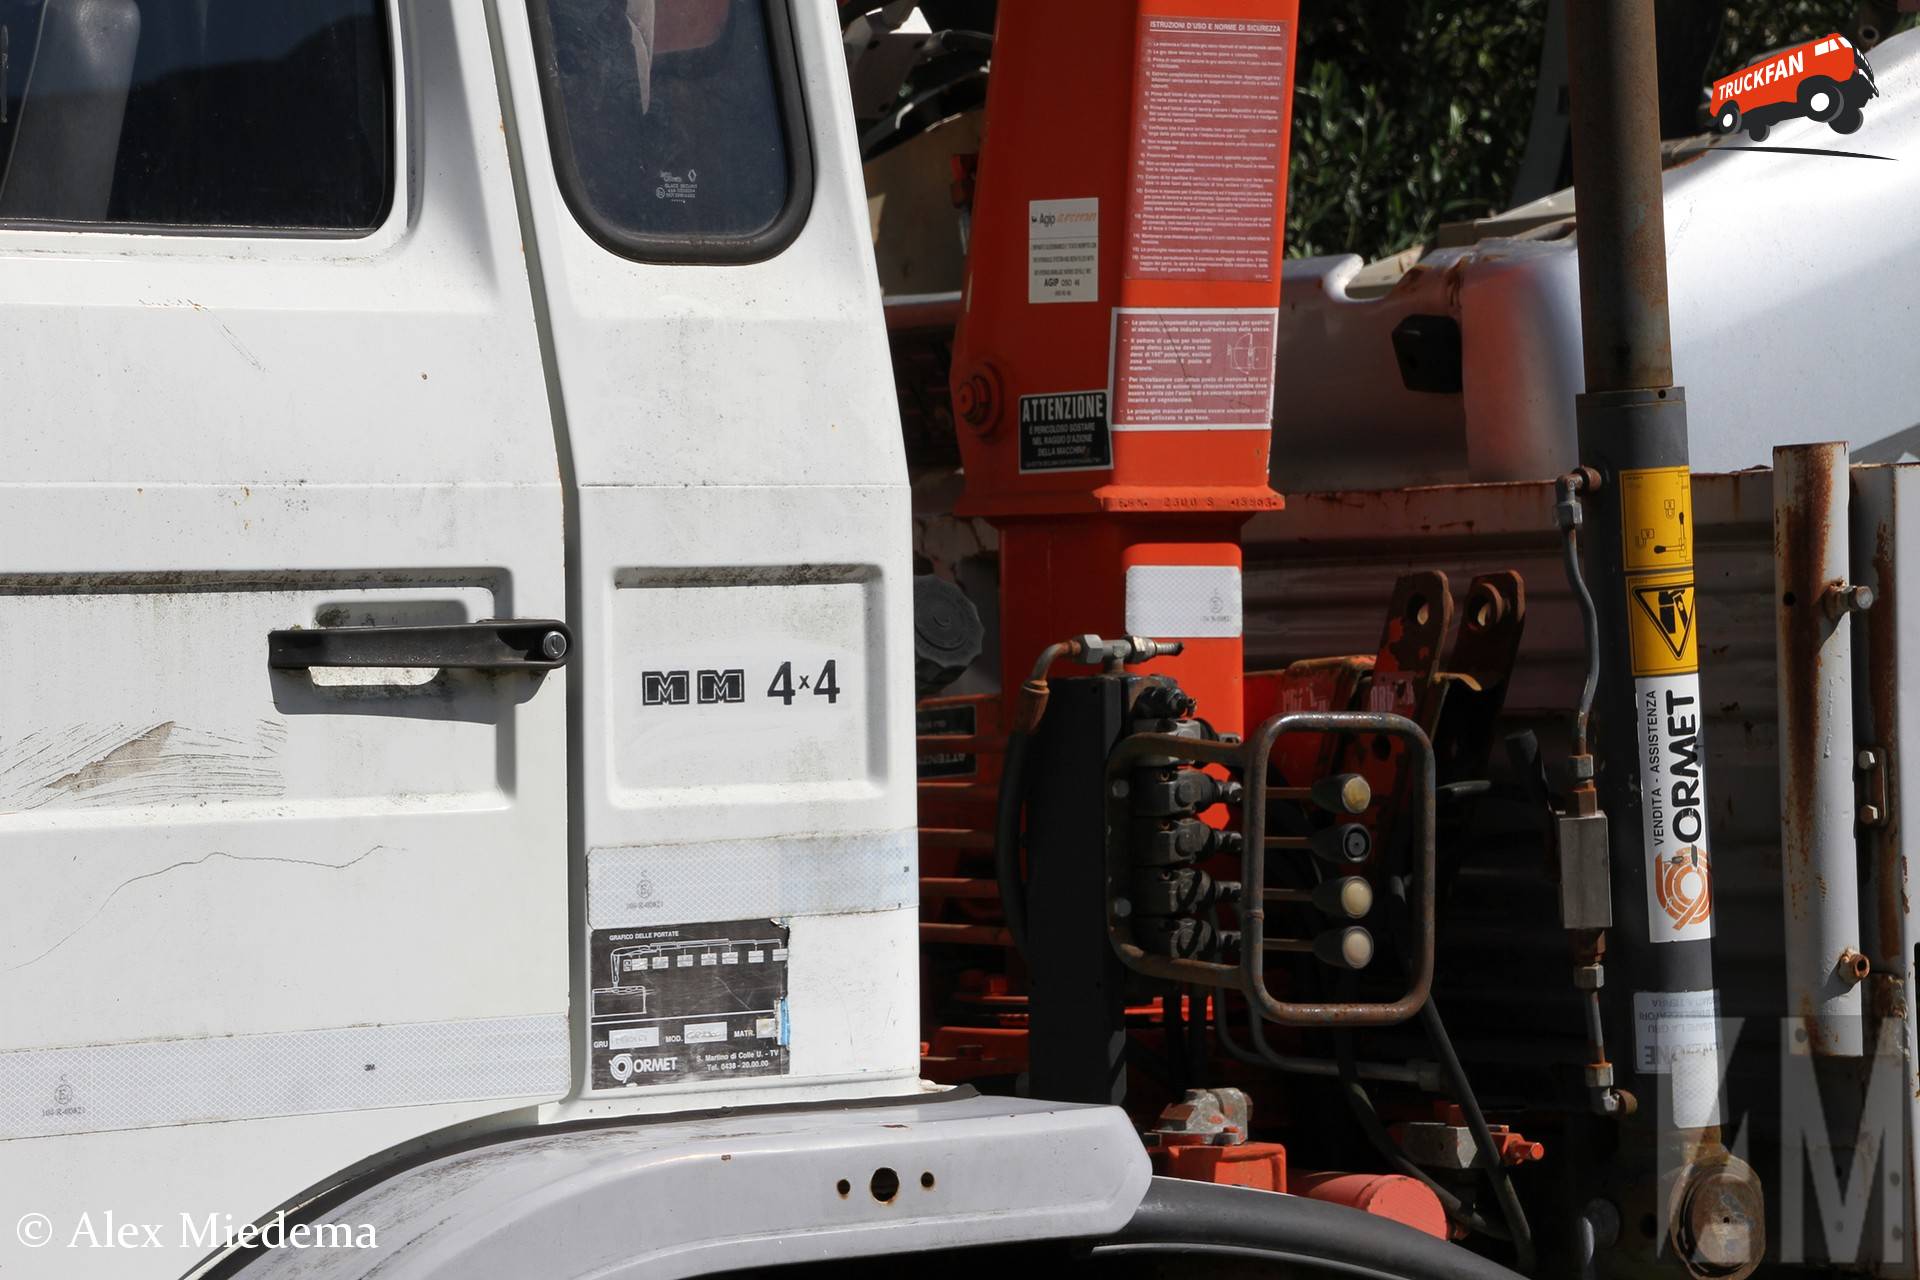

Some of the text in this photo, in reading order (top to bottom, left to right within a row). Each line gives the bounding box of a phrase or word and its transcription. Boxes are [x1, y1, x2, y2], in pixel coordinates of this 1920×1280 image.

[1150, 21, 1185, 30] ISTRUZIONI
[1214, 23, 1237, 31] NORME
[1247, 24, 1281, 33] SICUREZZA
[1022, 394, 1104, 423] ATTENZIONE
[1645, 690, 1660, 774] ASSISTENZA
[1665, 689, 1702, 843] ORMET
[1651, 787, 1664, 846] VENDITA
[609, 930, 679, 942] GRAFICO DELLE PORTATE
[593, 1041, 608, 1049] GRU
[665, 1035, 684, 1043] MOD.
[734, 1029, 755, 1038] MATR.
[705, 1053, 729, 1062] Martino
[730, 1052, 737, 1060] di
[738, 1051, 755, 1059] Colle
[756, 1050, 764, 1058] U.
[769, 1049, 779, 1057] TV
[633, 1057, 678, 1073] ORMET
[706, 1063, 719, 1071] Tel.
[721, 1062, 736, 1070] 0438
